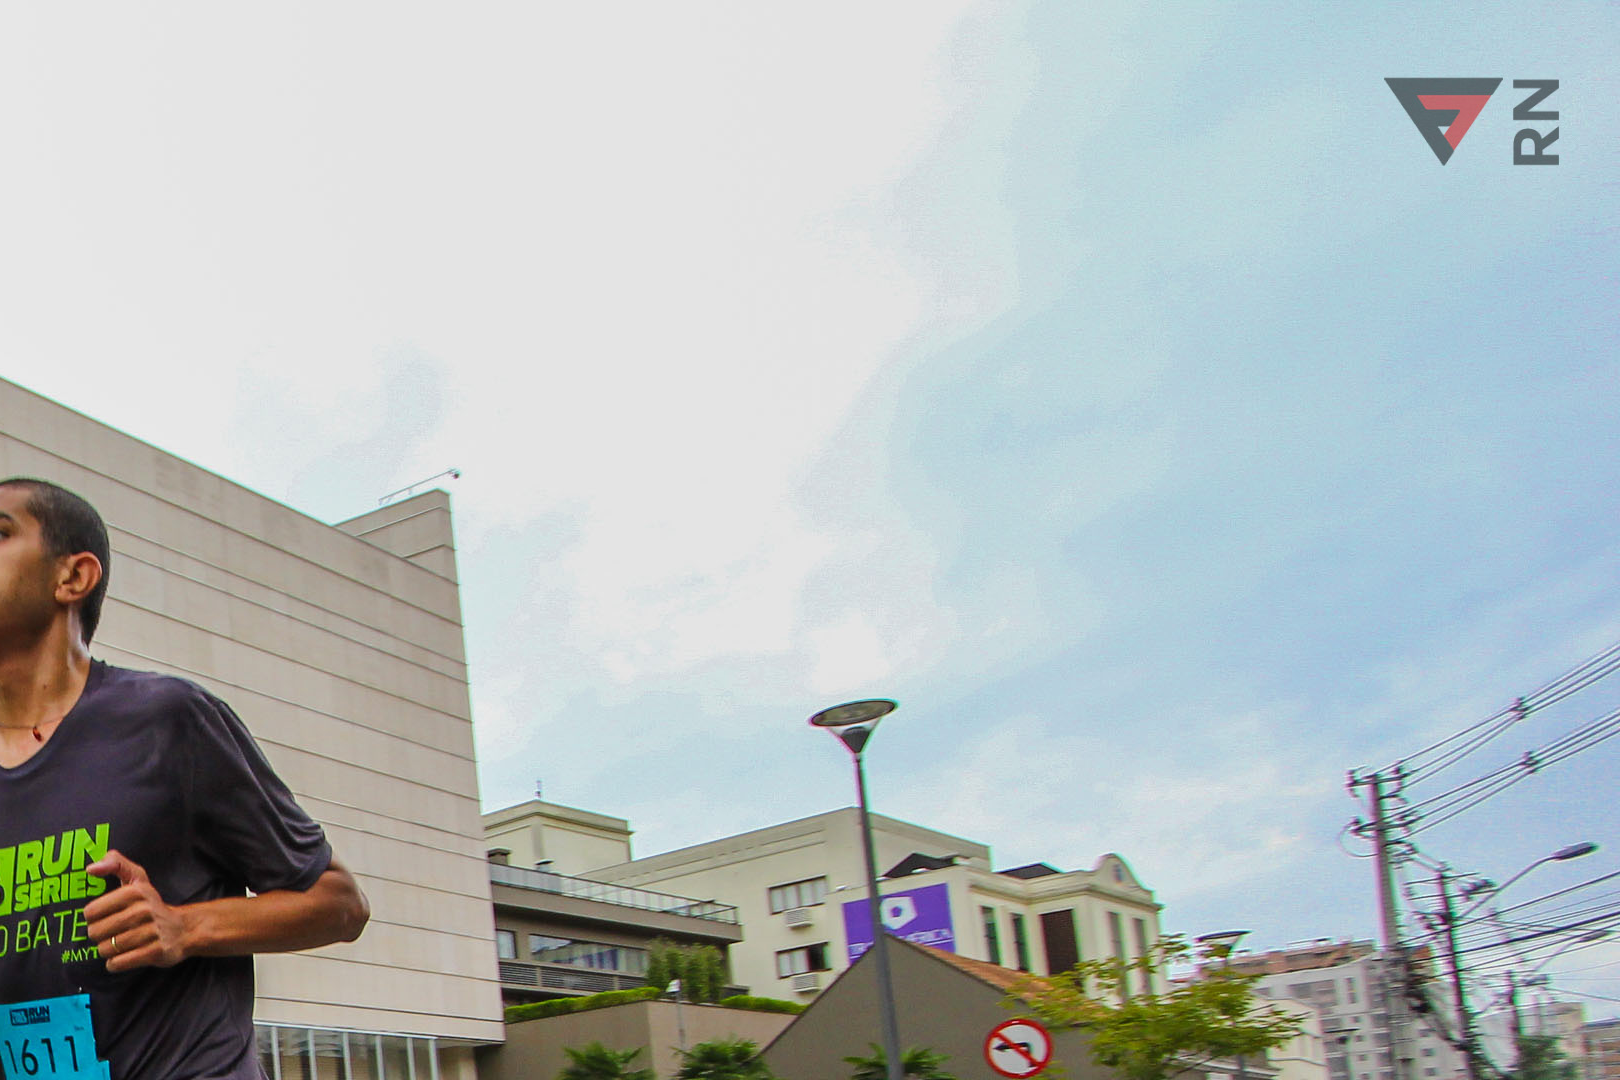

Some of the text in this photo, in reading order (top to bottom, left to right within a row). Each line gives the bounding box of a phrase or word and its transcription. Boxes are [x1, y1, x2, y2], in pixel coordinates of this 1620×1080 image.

[15, 823, 110, 885] RUN
[13, 870, 107, 913] SERIES
[15, 908, 88, 953] BATE
[61, 945, 100, 965] #MYT
[4, 1035, 79, 1076] 1611
